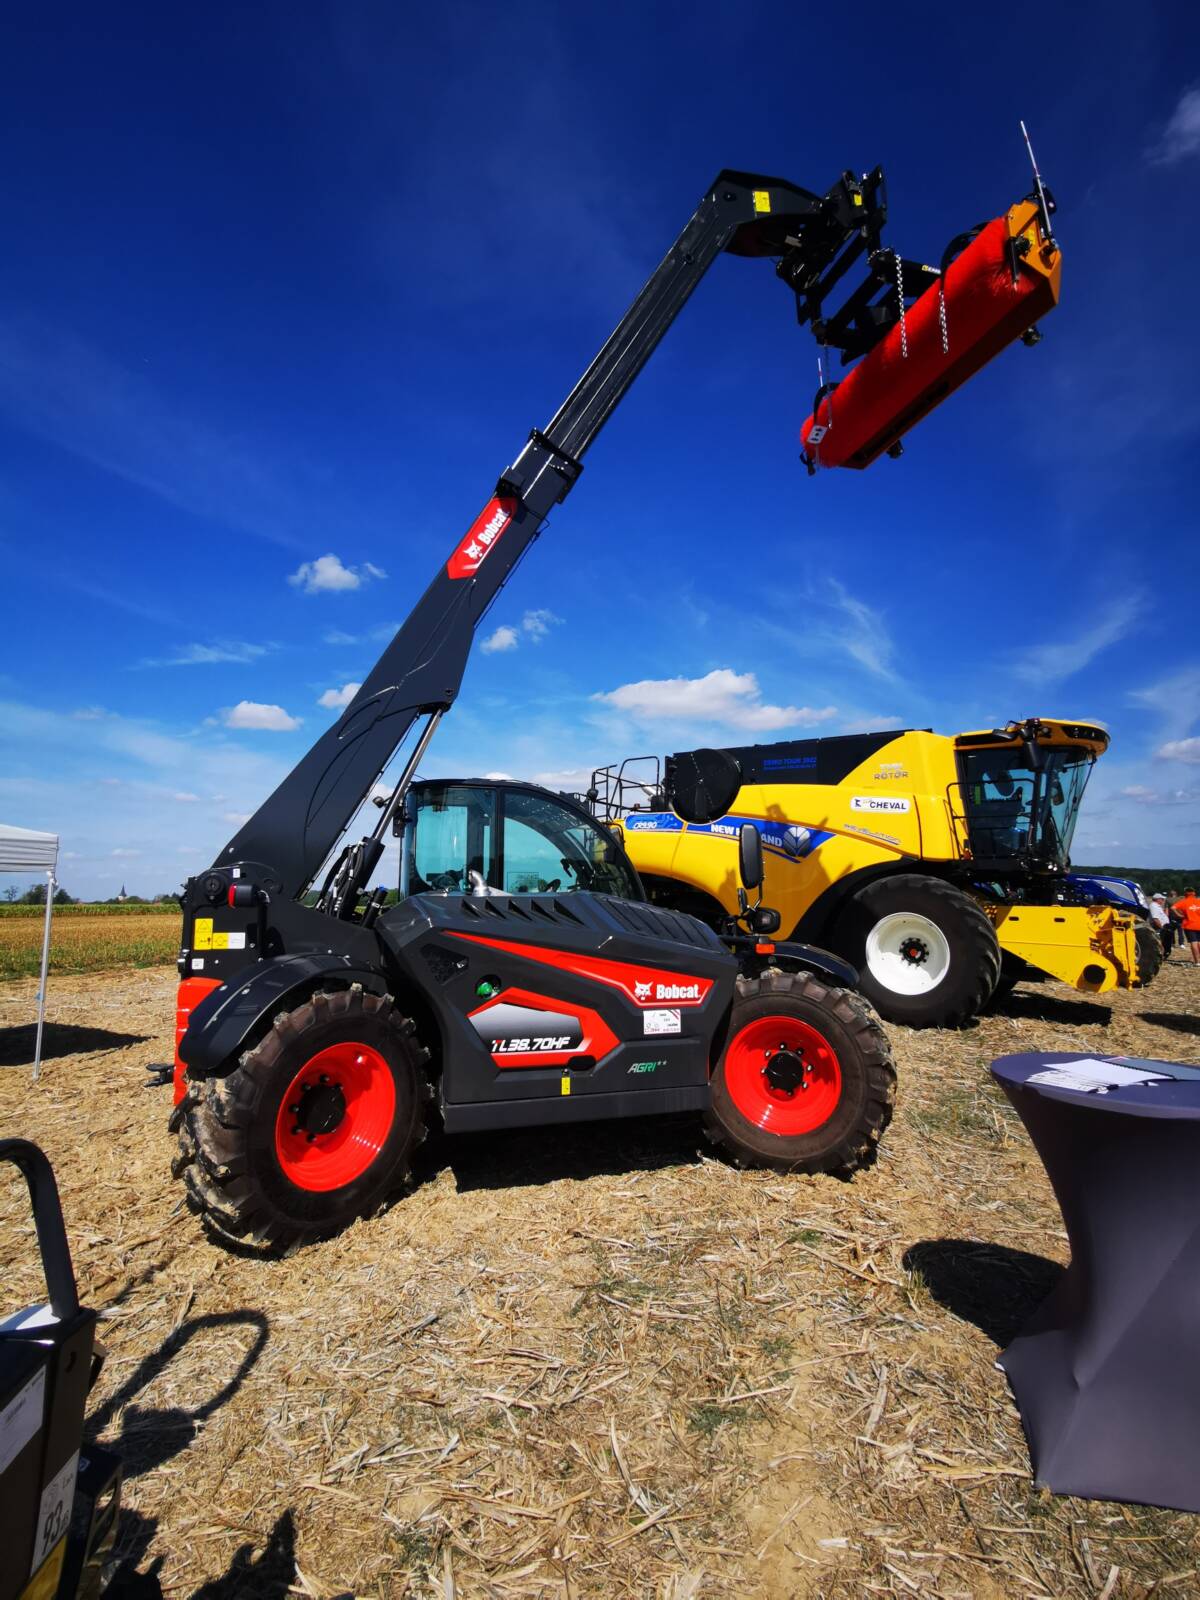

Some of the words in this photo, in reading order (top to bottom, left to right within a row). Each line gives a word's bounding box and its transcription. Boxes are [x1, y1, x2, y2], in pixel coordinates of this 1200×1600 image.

[477, 508, 510, 545] Bobcat
[874, 771, 909, 781] ROTOR
[869, 801, 907, 810] CHEVAL
[711, 824, 735, 835] NEW
[656, 984, 700, 999] Bobcat
[492, 1036, 571, 1052] TL38.70HF
